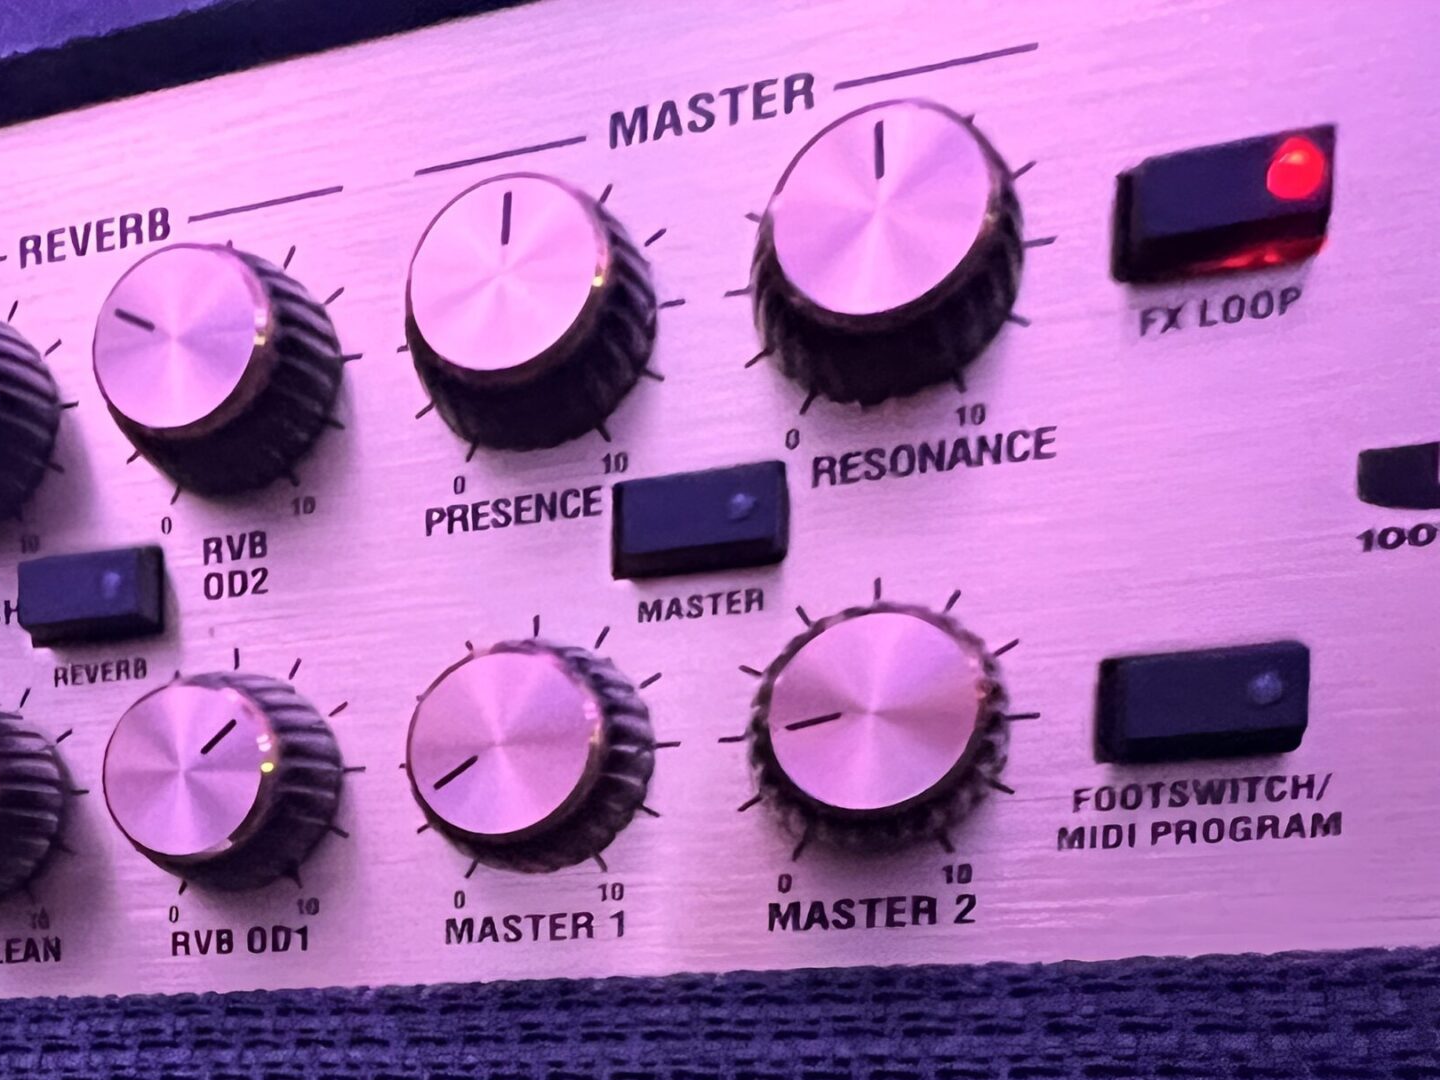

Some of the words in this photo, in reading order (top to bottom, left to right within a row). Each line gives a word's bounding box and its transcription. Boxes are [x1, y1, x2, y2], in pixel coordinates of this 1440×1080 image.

[609, 72, 815, 149] MASTER
[19, 207, 171, 269] REVERB
[1140, 305, 1183, 336] FX
[1200, 287, 1302, 327] LOOP
[786, 429, 800, 450] 0
[956, 403, 985, 426] 10
[453, 475, 465, 495] 0
[602, 452, 628, 474] 10
[811, 427, 1057, 488] RESONANCE
[161, 516, 172, 536] 0
[292, 496, 316, 516] 10
[425, 485, 603, 537] PRESENCE
[203, 531, 268, 566] RVB
[204, 567, 269, 601] OD2
[637, 588, 764, 623] MASTER
[54, 657, 148, 687] REVERB
[1072, 773, 1333, 813] FOOTSWITCH/
[1058, 822, 1136, 851] MIDI
[1151, 811, 1342, 846] PROGRAM
[454, 889, 465, 909] 0
[598, 883, 624, 903] 10
[778, 873, 792, 893] 0
[943, 864, 972, 885] 10
[168, 905, 179, 924] 0
[298, 897, 320, 916] 10
[446, 912, 594, 944] MASTER
[610, 910, 625, 937] 1
[769, 896, 937, 931] MASTER
[955, 894, 976, 925] 2
[171, 929, 234, 956] RVB
[247, 927, 309, 953] OD1
